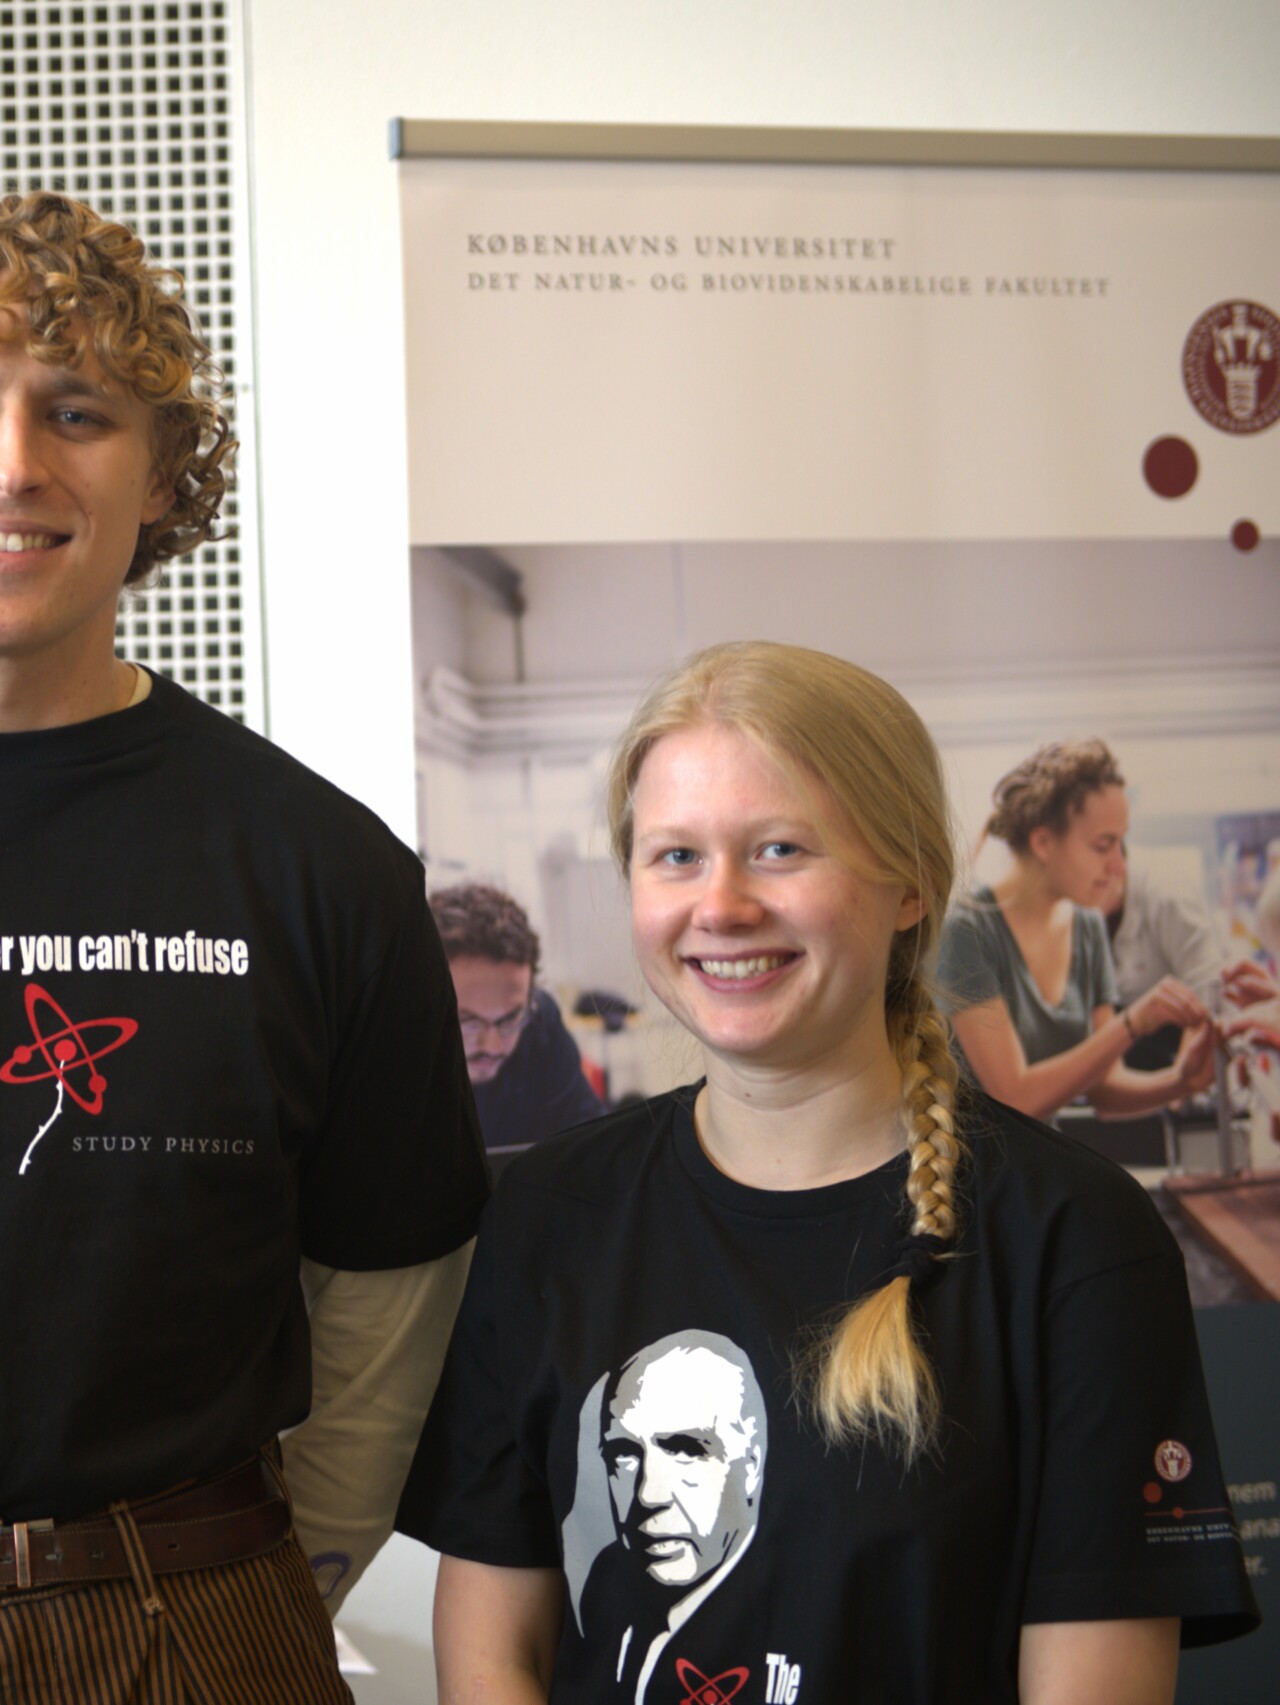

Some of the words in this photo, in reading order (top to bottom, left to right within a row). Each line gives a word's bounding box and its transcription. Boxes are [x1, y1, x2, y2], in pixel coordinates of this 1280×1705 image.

[466, 233, 679, 257] KØBENHAVNS
[694, 235, 895, 260] UNIVERSITET
[467, 272, 520, 291] DET
[533, 272, 637, 292] NATUR-
[650, 272, 689, 292] OG
[701, 273, 972, 296] BIOVIDENSKABELIGE
[984, 276, 1110, 298] FAKULTET
[19, 934, 73, 976] you
[78, 928, 150, 972] can't
[154, 929, 250, 976] refuse
[72, 1135, 152, 1152] STUDY
[165, 1136, 256, 1155] PHYSICS
[765, 1652, 802, 1705] The
